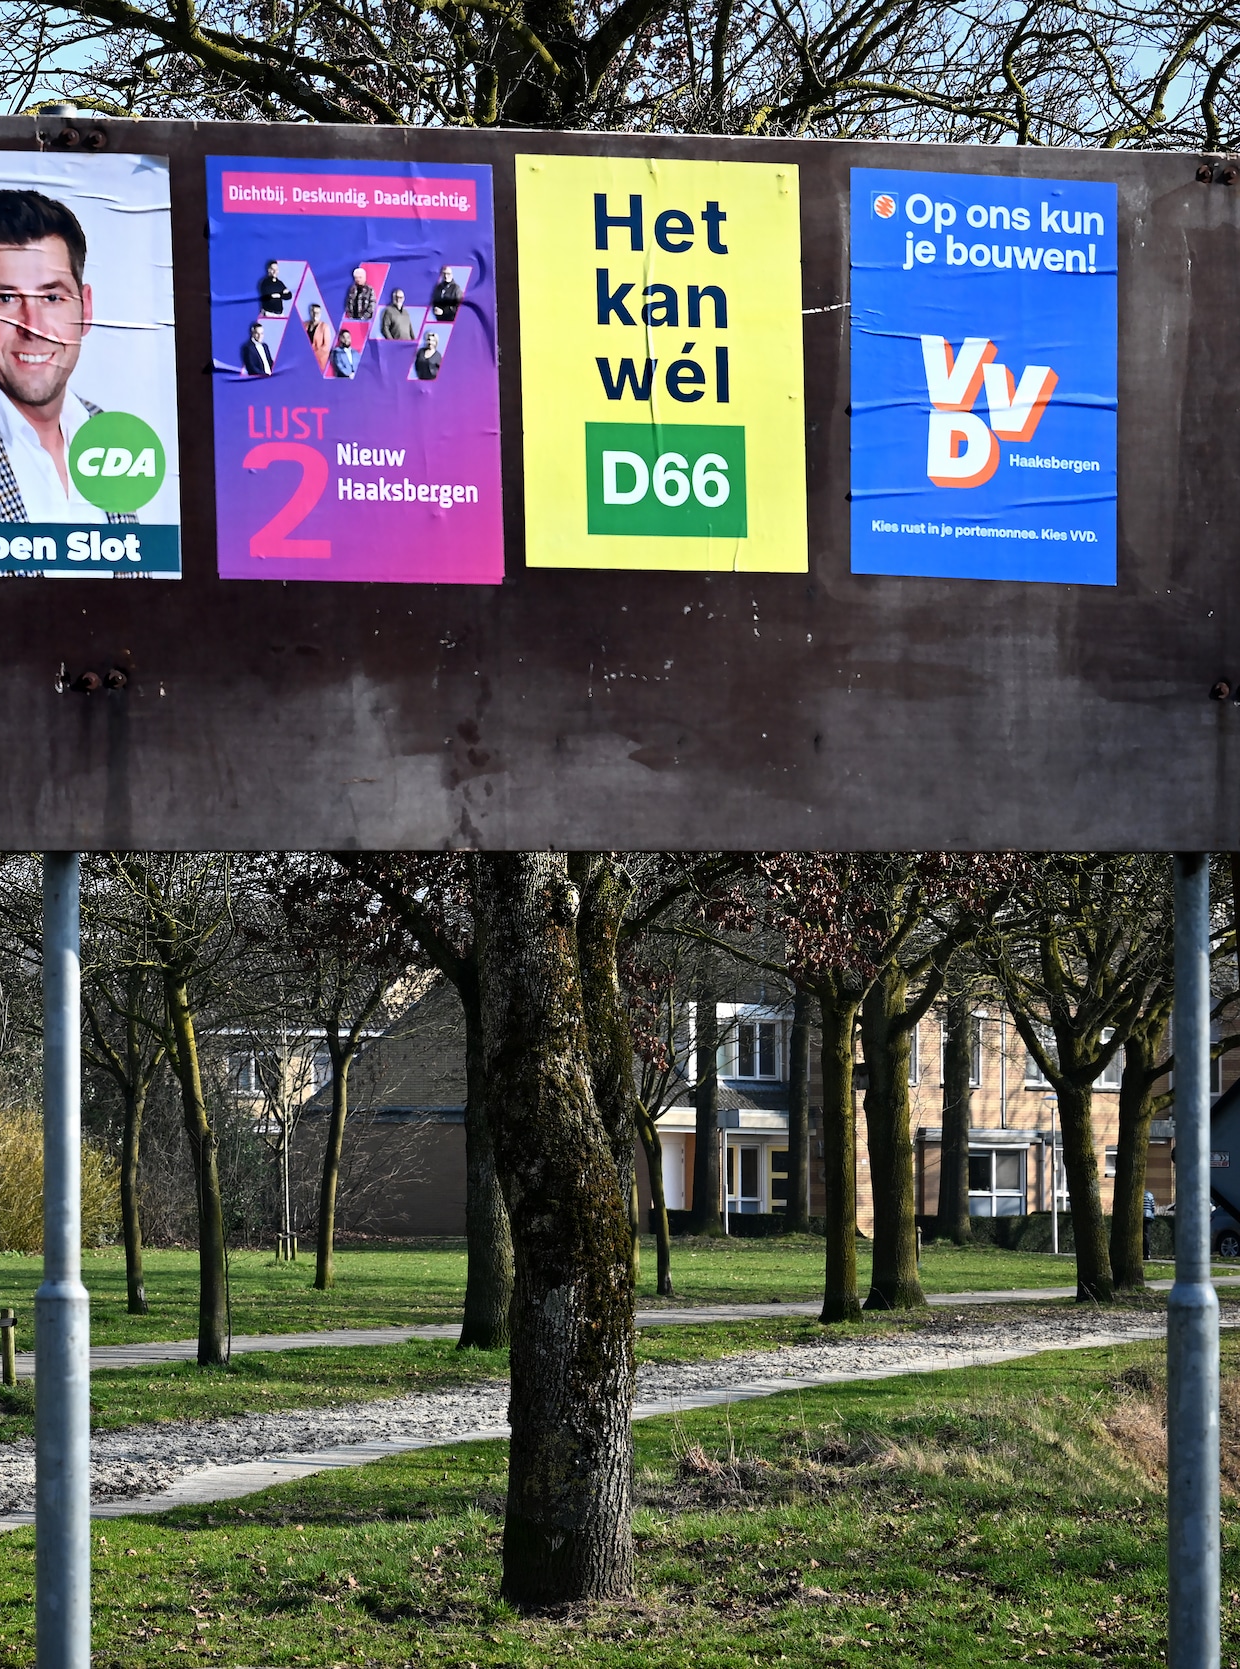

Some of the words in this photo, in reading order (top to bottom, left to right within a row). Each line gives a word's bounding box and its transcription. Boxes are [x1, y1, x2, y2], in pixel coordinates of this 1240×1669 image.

[228, 185, 288, 205] Dichtbij.
[292, 187, 369, 208] Deskundig.
[373, 189, 471, 212] Daadkrachtig.
[905, 193, 957, 234] Op
[966, 204, 1030, 231] ons
[1041, 202, 1104, 236] kun
[594, 193, 728, 254] Het
[903, 231, 936, 270] je
[946, 235, 1096, 274] bouwen!
[596, 268, 728, 328] kan
[595, 342, 730, 403] wél
[248, 405, 329, 440] LIJST
[77, 447, 156, 478] CDA
[336, 442, 406, 467] Nieuw
[1009, 454, 1100, 473] Haaksbergen
[337, 477, 478, 508] Haaksbergen
[602, 450, 730, 507] D66
[242, 442, 331, 559] 2
[67, 531, 141, 562] Slot
[872, 520, 898, 533] Kies
[901, 522, 926, 534] rust
[928, 522, 939, 535] in
[940, 523, 952, 538] je
[955, 526, 1039, 540] portemonnee.
[1041, 528, 1067, 541] Kies
[1070, 530, 1098, 542] VVD.
